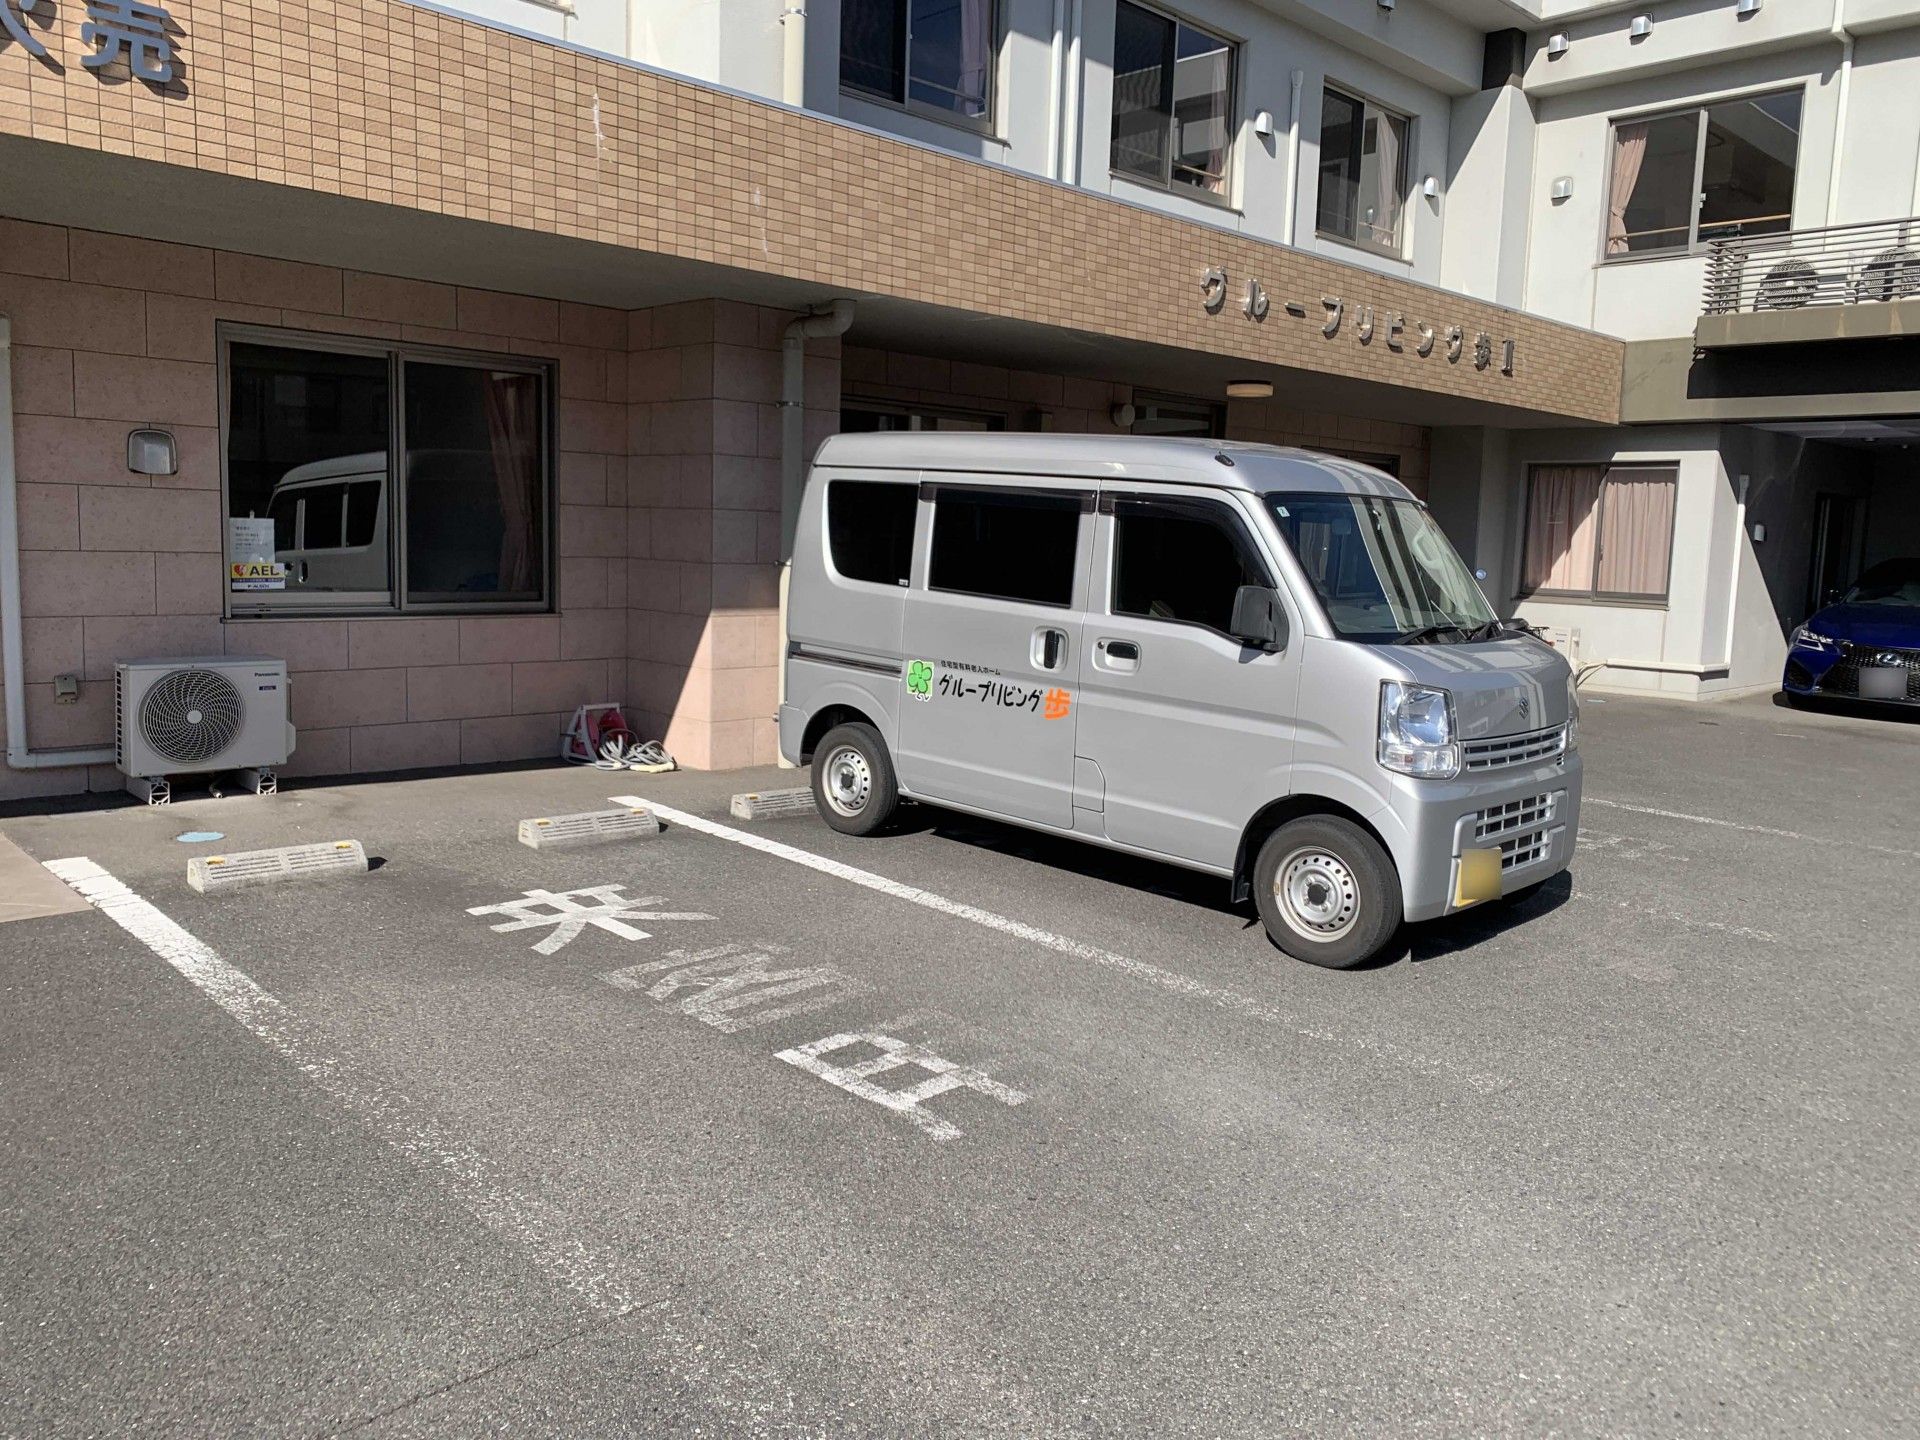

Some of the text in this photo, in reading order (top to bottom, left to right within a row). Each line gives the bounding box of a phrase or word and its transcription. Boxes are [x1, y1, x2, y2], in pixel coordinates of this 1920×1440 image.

[941, 660, 1001, 676] 住宅型有料老人ホーム
